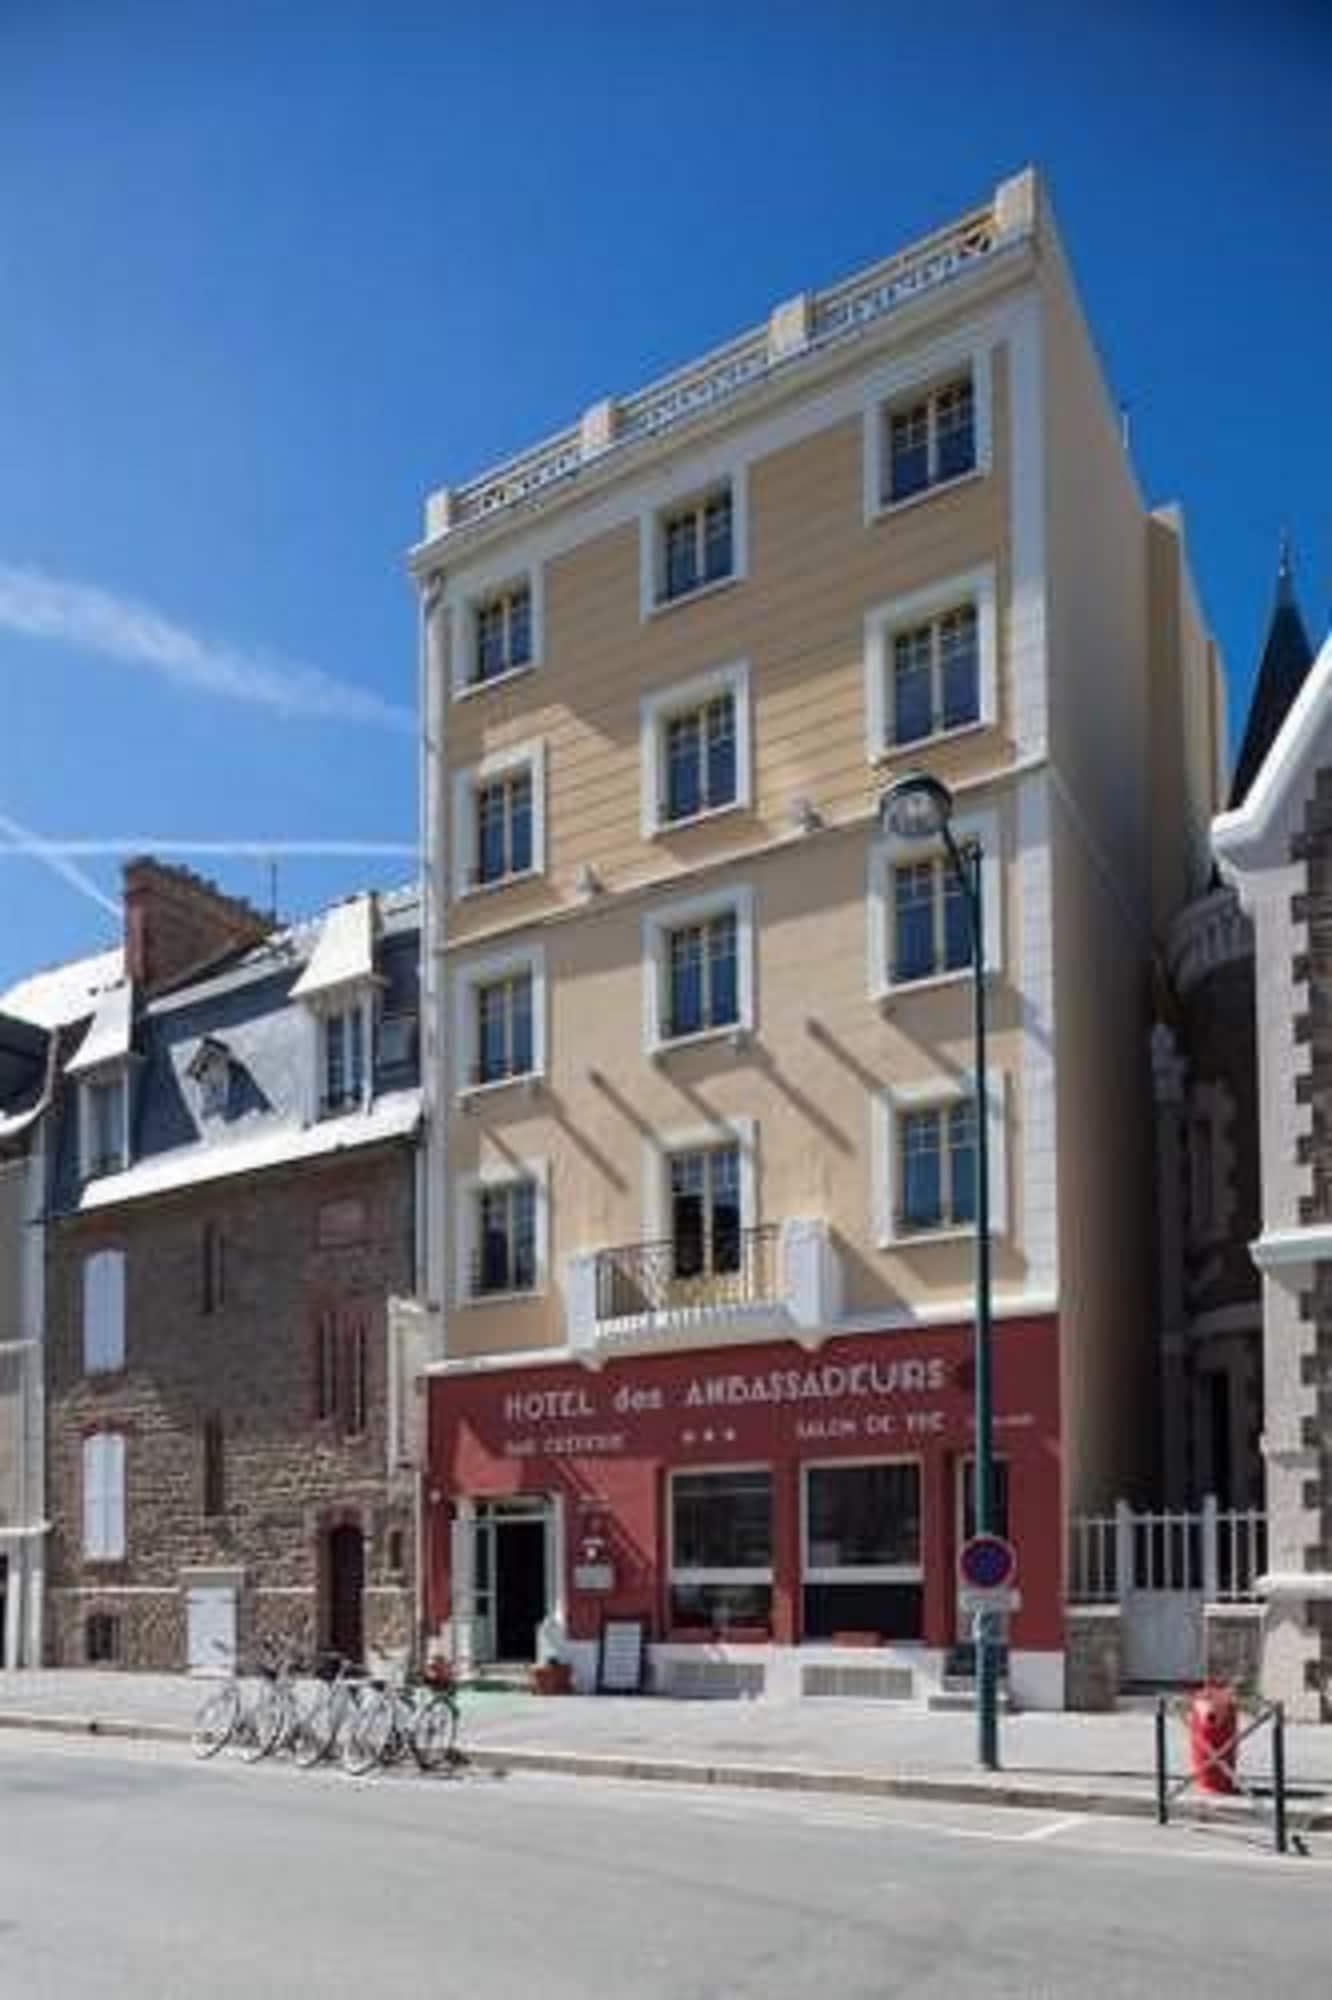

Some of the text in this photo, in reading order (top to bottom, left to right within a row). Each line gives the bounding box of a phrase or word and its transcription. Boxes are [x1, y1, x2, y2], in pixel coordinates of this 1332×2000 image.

[505, 1359, 945, 1421] HOTEL des AMBASSADEURS
